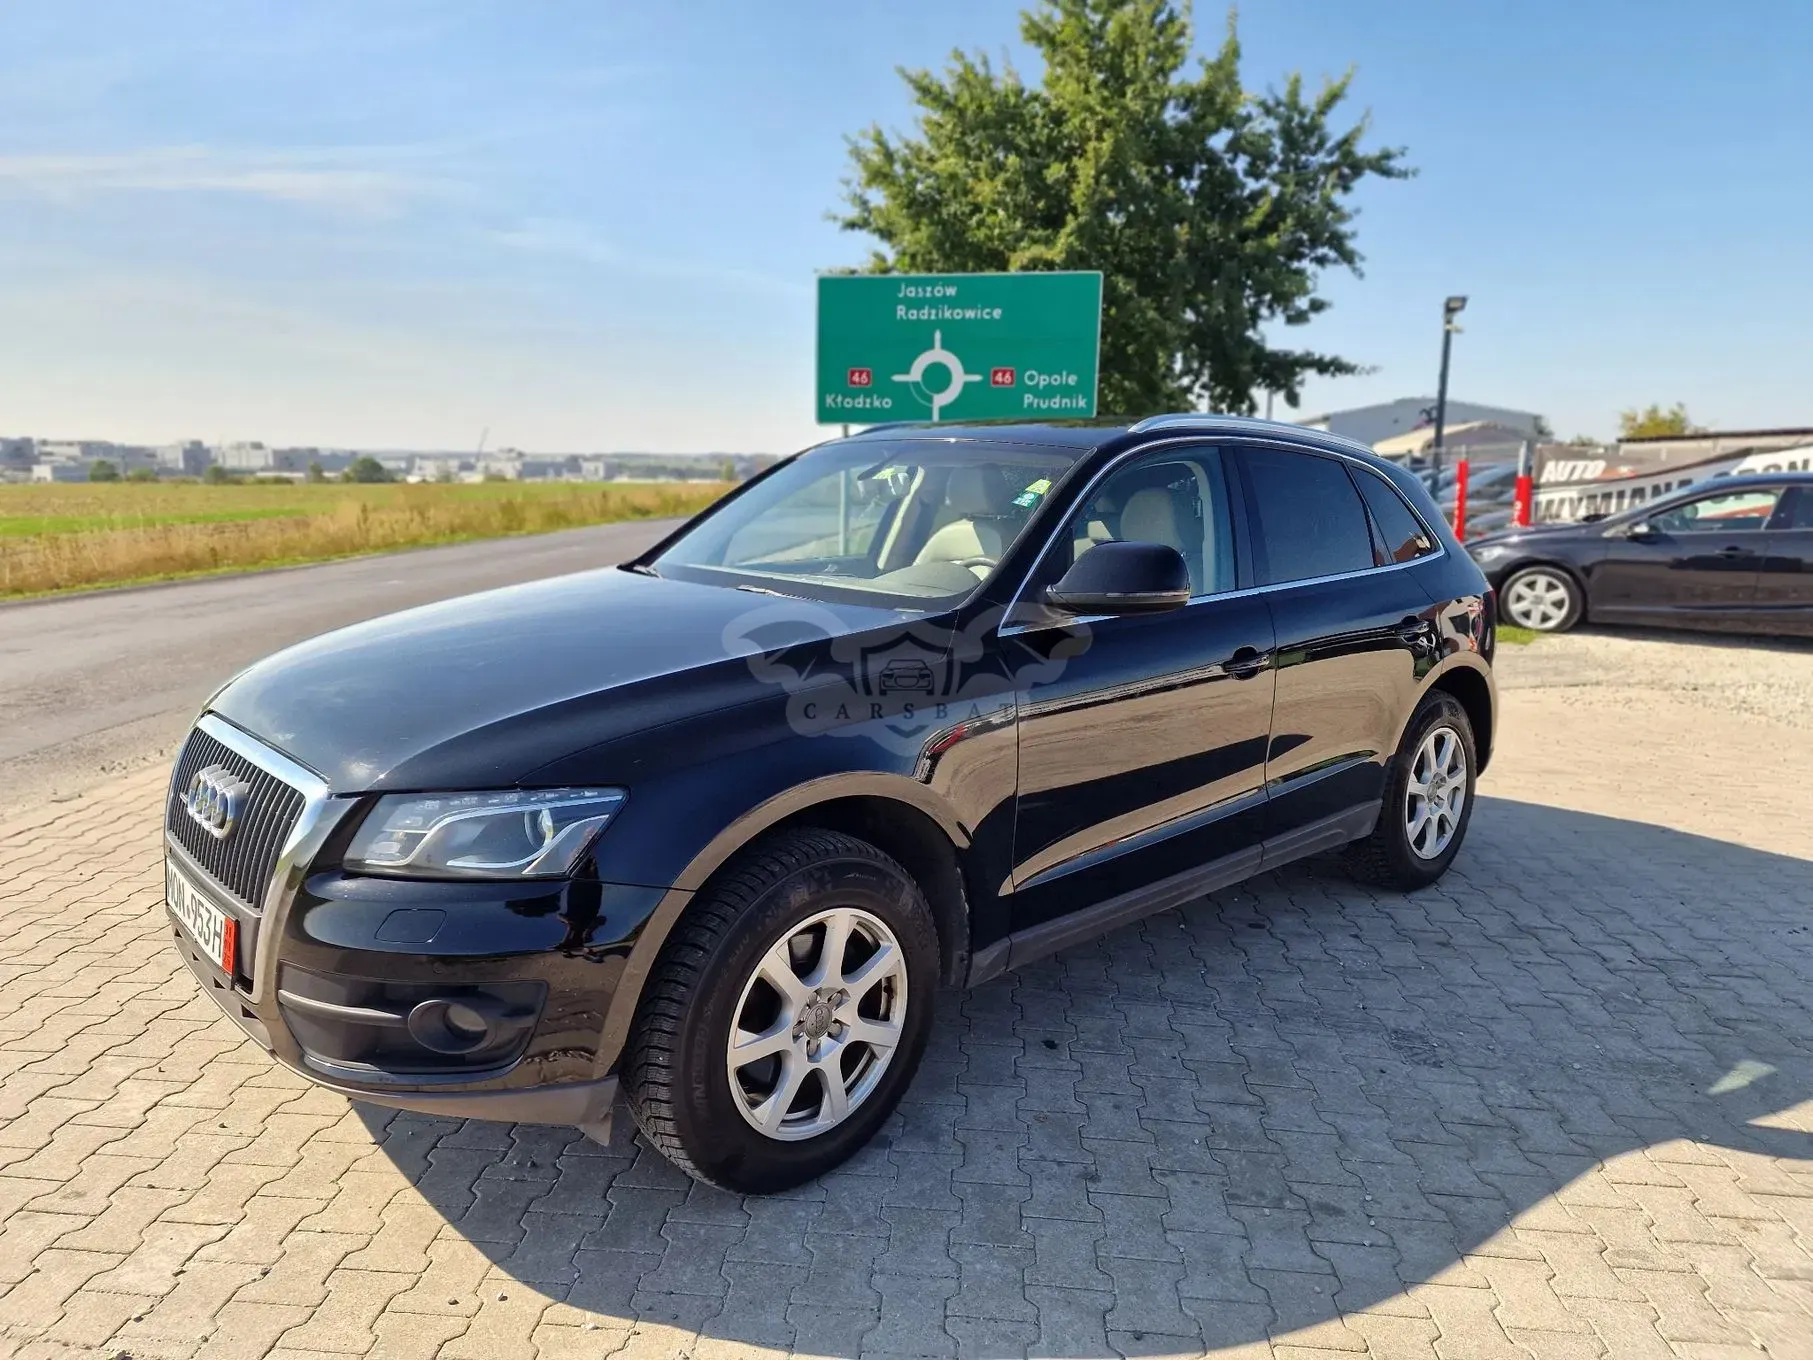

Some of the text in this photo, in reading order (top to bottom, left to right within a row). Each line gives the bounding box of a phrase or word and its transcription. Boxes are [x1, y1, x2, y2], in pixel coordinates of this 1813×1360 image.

[897, 282, 957, 298] Jaszów
[896, 304, 1002, 320] Radzikowice
[852, 371, 869, 385] 46
[995, 371, 1012, 385] 46
[1023, 370, 1078, 389] Opole
[825, 393, 892, 409] Kłodzko
[1023, 393, 1087, 409] Prudnik
[1540, 459, 1607, 483] AUTO
